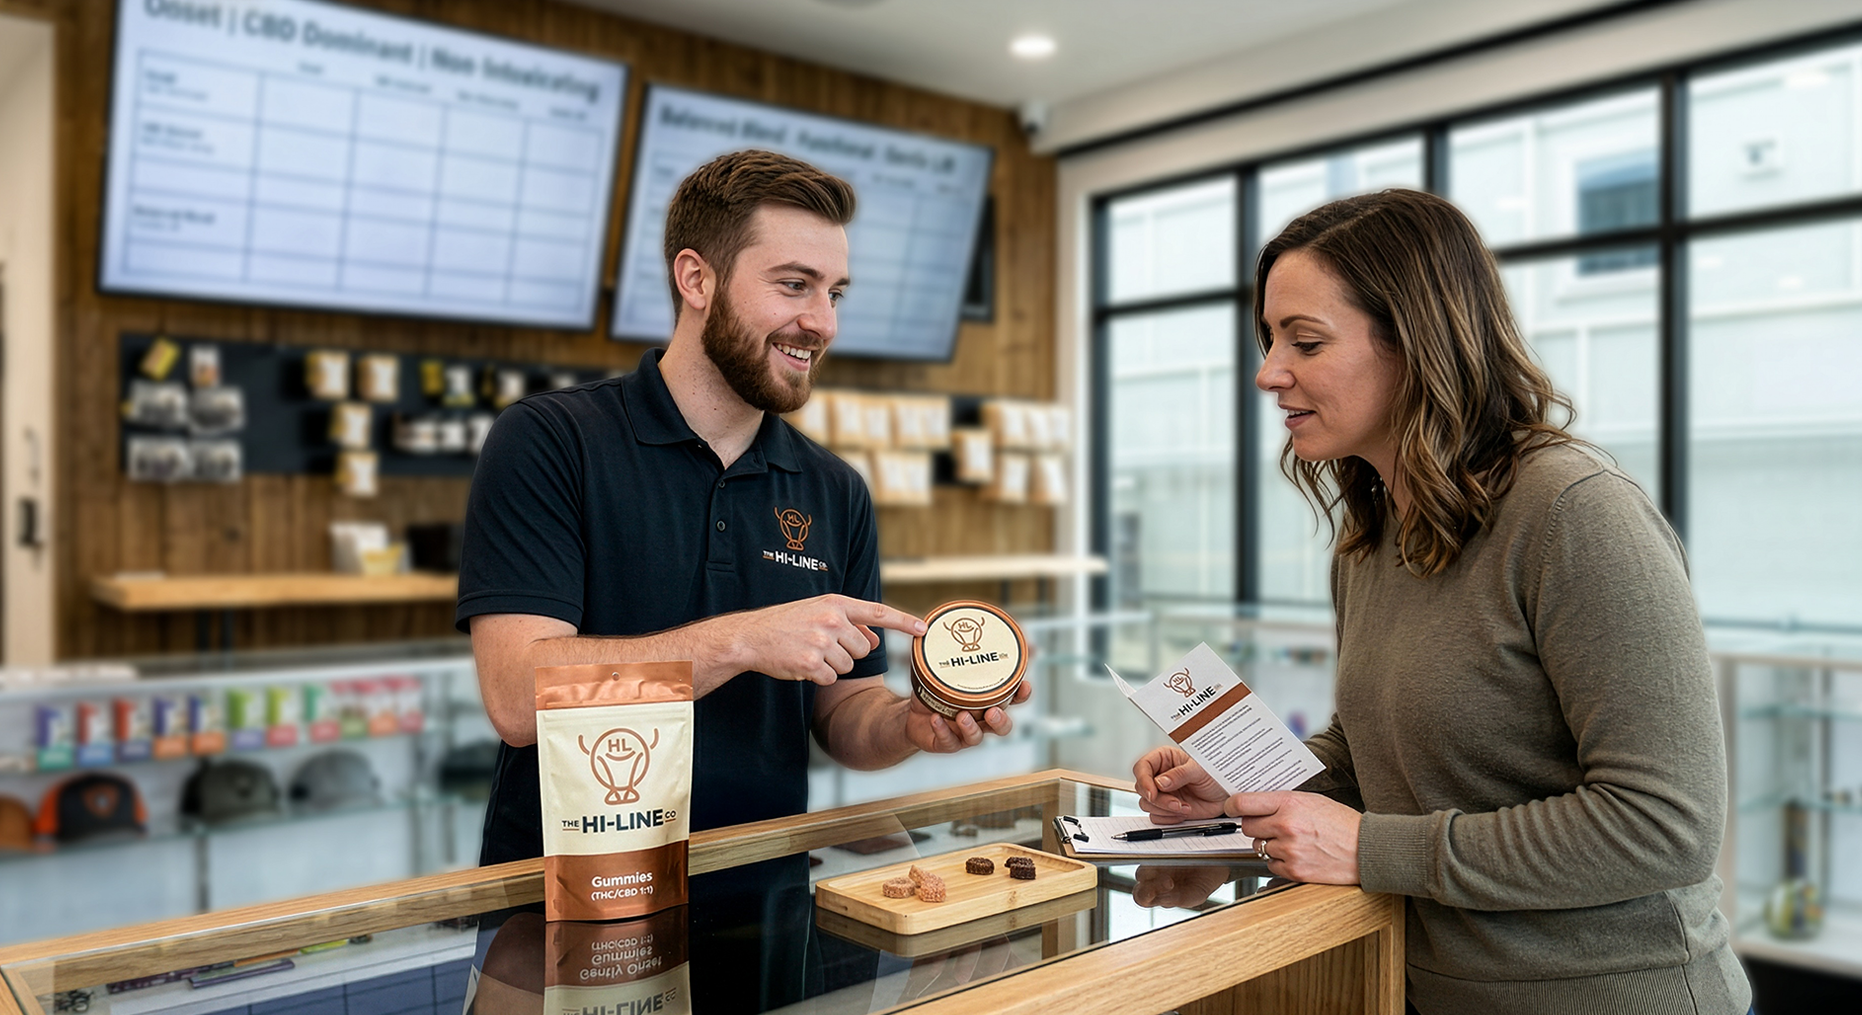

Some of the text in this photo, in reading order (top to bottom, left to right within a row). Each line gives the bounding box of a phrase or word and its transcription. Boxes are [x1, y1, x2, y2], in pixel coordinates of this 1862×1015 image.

[244, 9, 298, 41] CBD
[303, 21, 414, 67] Dominant
[775, 551, 819, 571] HI-LINE
[957, 621, 972, 629] HL
[950, 652, 999, 667] HI-LINE
[608, 738, 632, 752] HL
[562, 809, 677, 833] THE HI-LINE CO
[591, 871, 653, 888] Gummies
